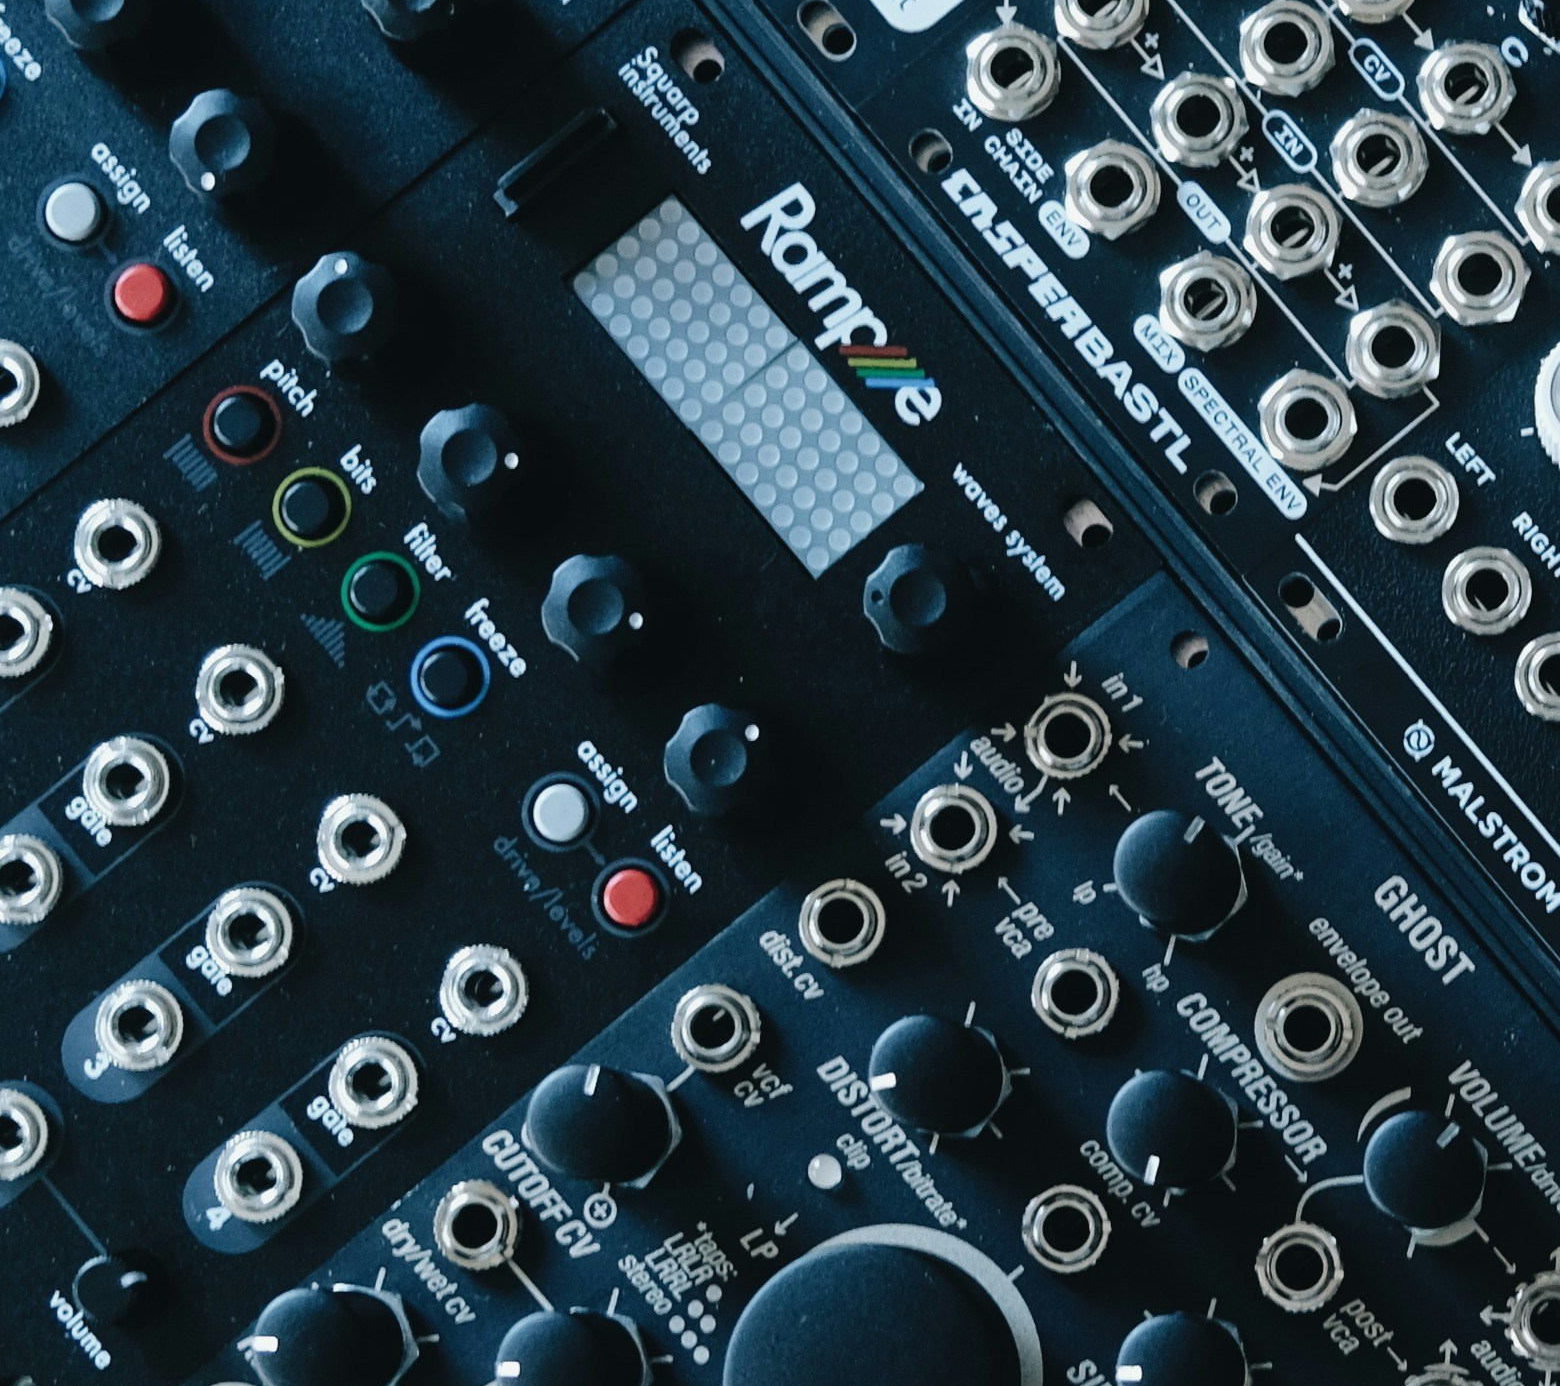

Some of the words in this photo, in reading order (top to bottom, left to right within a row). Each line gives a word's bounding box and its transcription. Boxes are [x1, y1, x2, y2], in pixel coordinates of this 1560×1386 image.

[615, 56, 713, 176] instruments
[629, 44, 701, 128] Squarp
[950, 96, 984, 134] IN
[88, 140, 152, 216] assign
[981, 133, 1044, 206] CHAIN
[1003, 126, 1056, 186] SIDE
[160, 223, 215, 295] listen
[257, 357, 319, 419] pitch
[337, 441, 378, 497] bits
[1181, 374, 1263, 475] SPECTRAL
[1263, 472, 1302, 512] ENV
[1443, 430, 1497, 488] LEFT
[401, 520, 453, 583] filter
[950, 461, 1009, 534] waves
[1003, 528, 1067, 603] system
[461, 595, 528, 680] freeze
[575, 739, 639, 815] assign
[967, 734, 1026, 796] audio
[648, 822, 704, 896] listen
[1372, 873, 1477, 987] GHOST
[1306, 916, 1392, 1010] envelope
[1381, 1005, 1425, 1046] out
[1174, 991, 1329, 1167] COMPRESSOR
[479, 1127, 574, 1223] CUTOFF
[552, 1218, 602, 1261] CV
